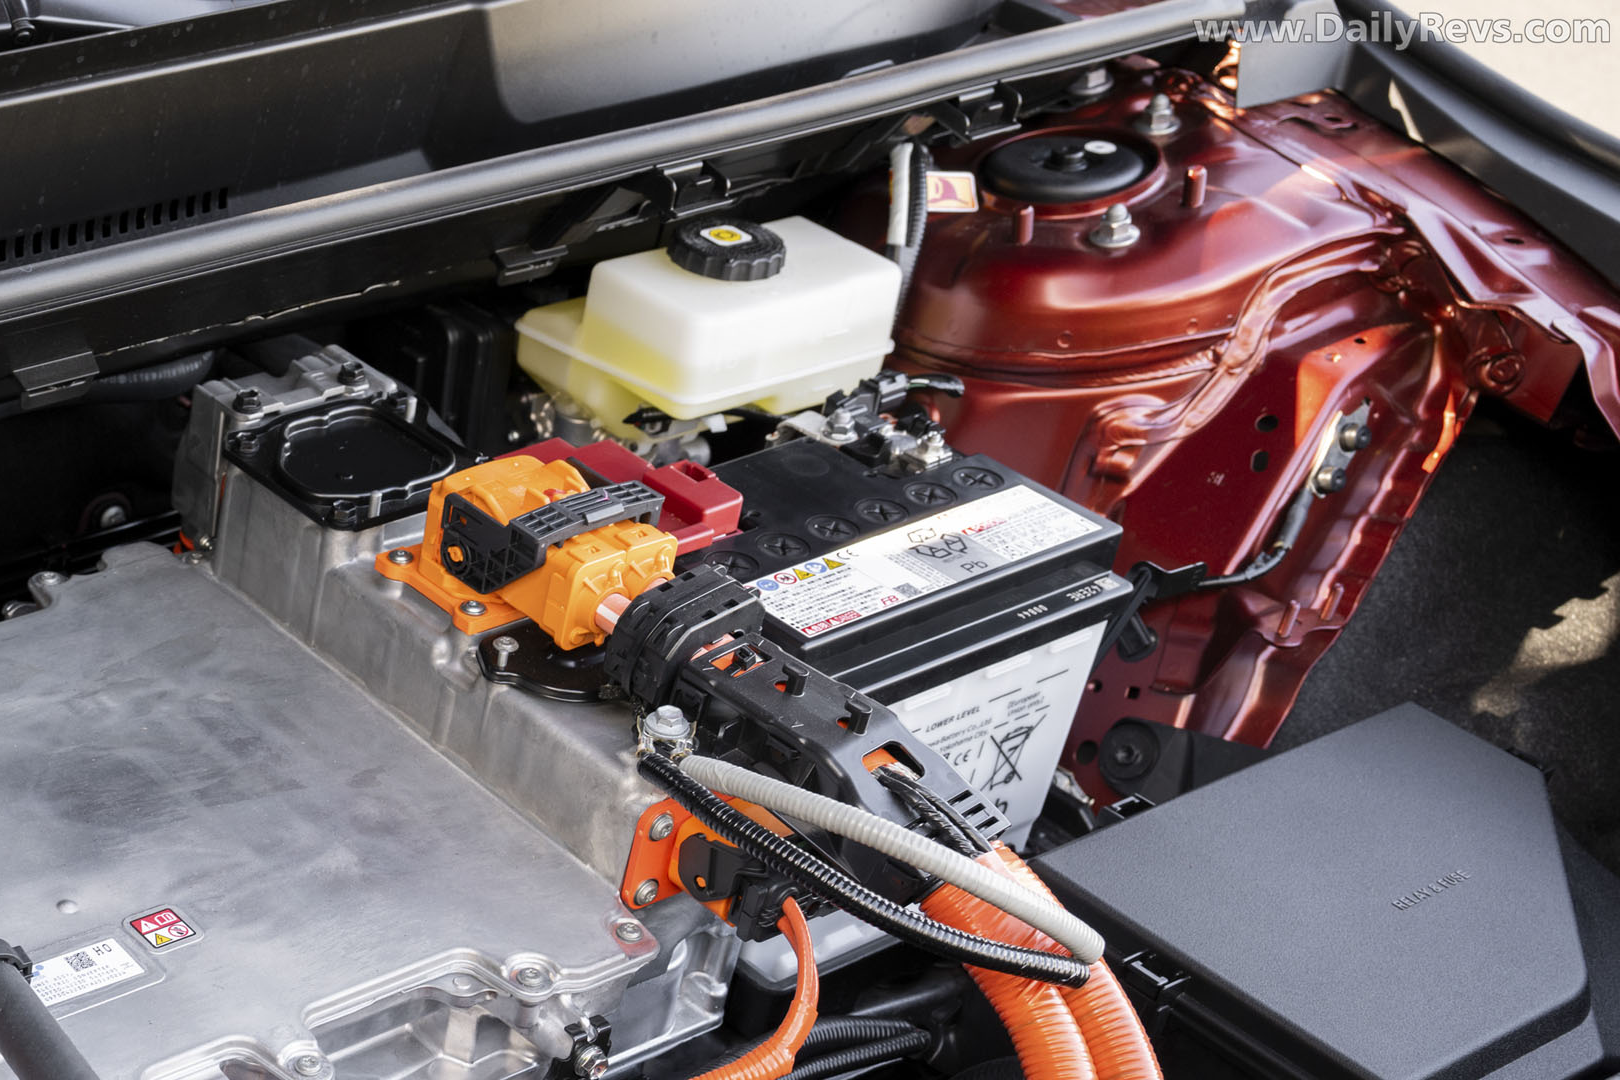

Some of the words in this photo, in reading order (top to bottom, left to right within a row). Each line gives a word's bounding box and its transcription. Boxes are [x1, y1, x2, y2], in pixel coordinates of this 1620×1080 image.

[960, 561, 988, 573] Pb
[926, 715, 955, 733] LOWER
[956, 706, 980, 720] LEVEL
[1391, 888, 1431, 910] RELAY
[1428, 883, 1444, 893] &
[1436, 870, 1470, 888] FUSE
